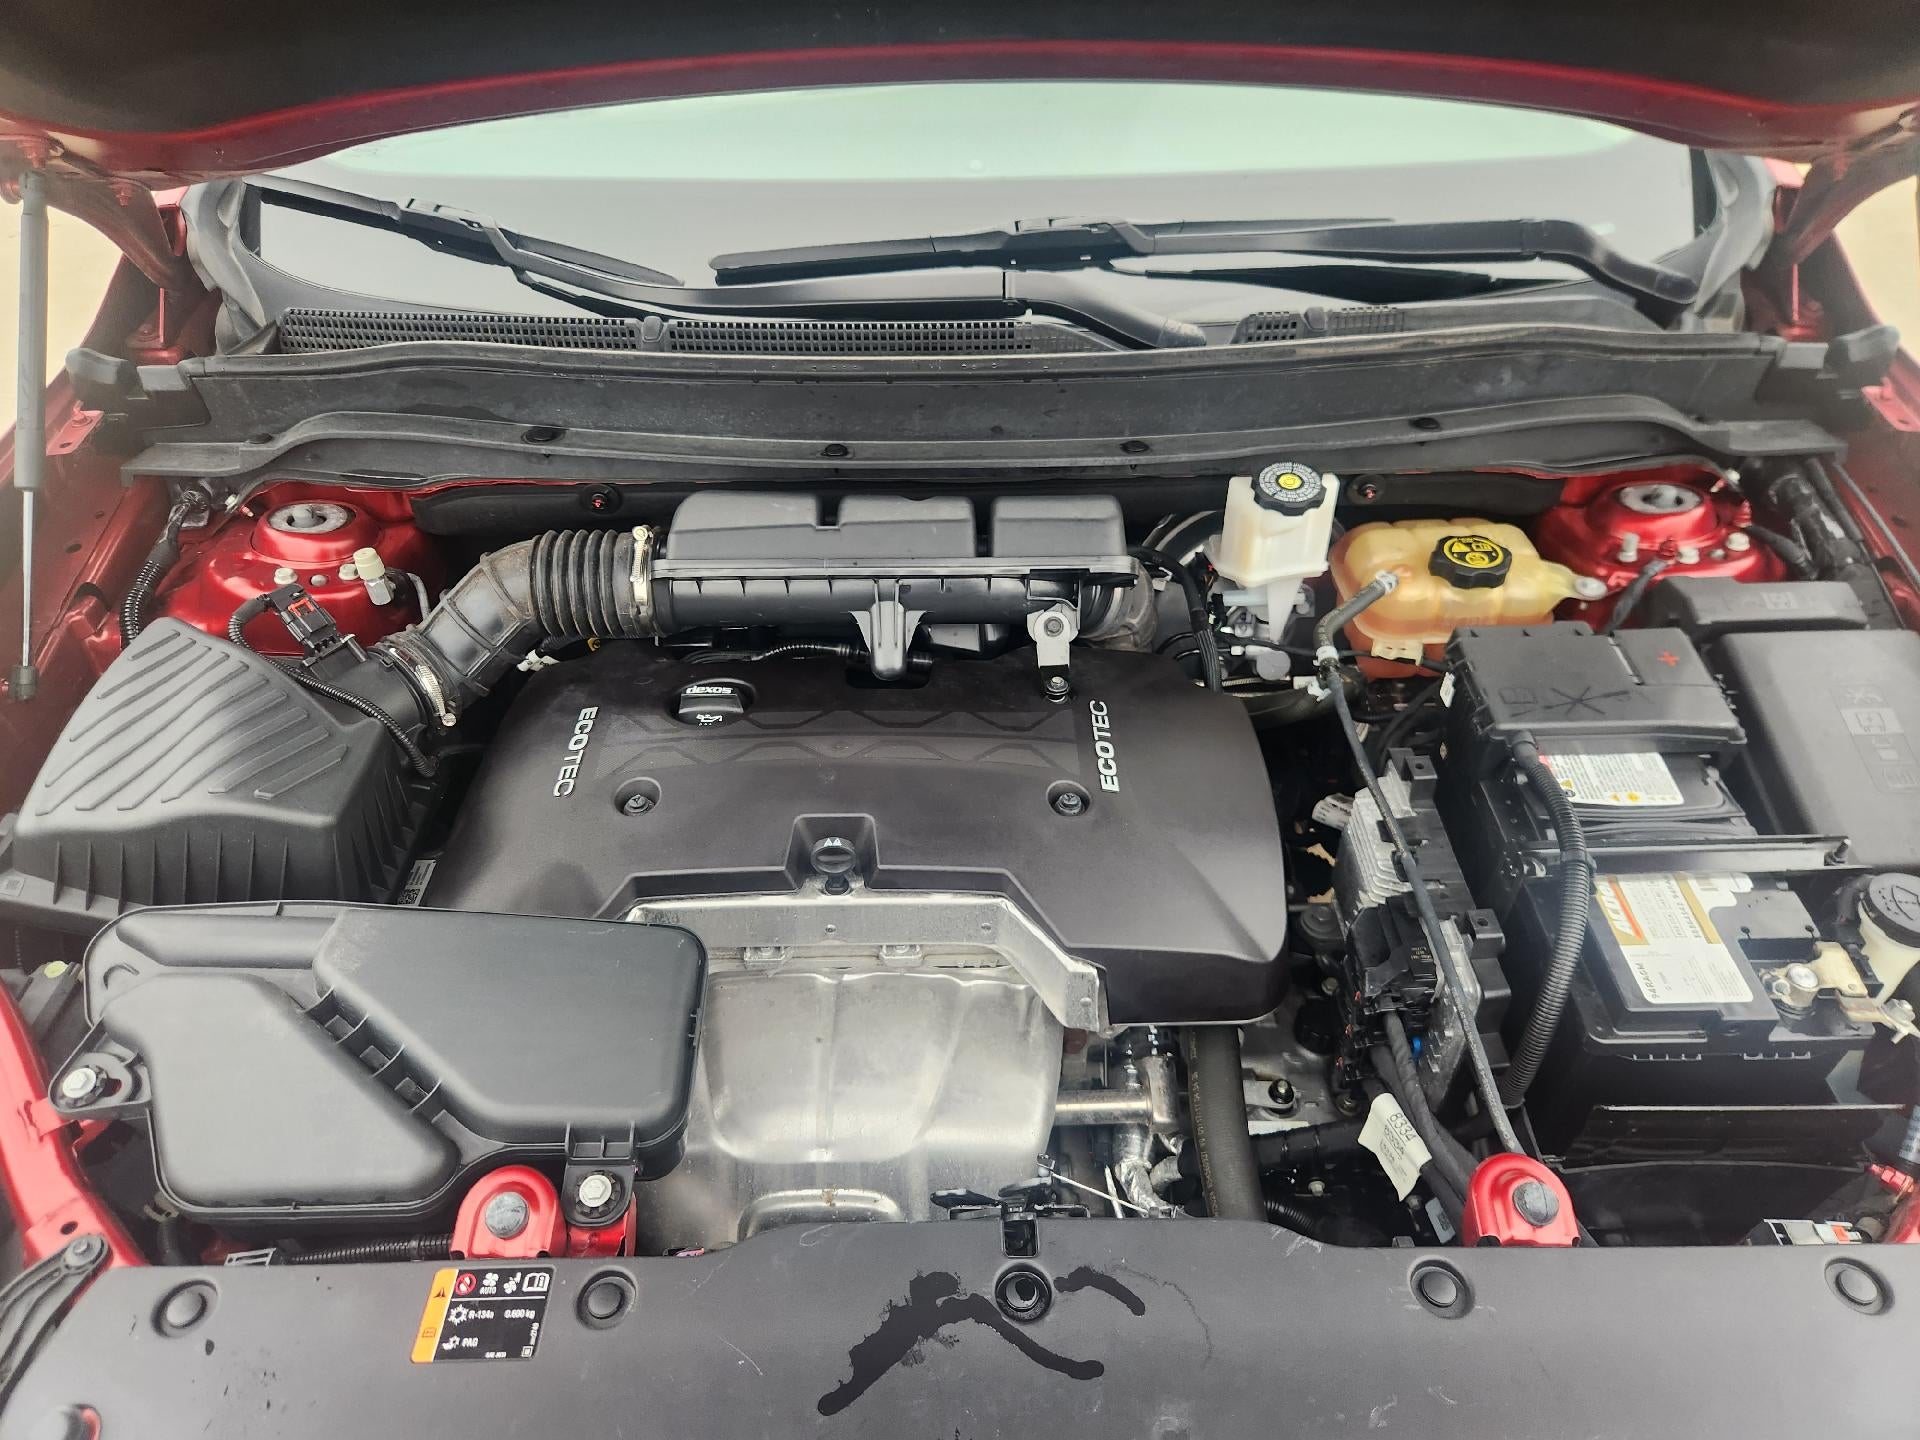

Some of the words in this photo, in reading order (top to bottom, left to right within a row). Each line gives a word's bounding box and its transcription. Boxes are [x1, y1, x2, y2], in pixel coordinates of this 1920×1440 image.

[685, 685, 733, 694] dexos
[553, 706, 599, 798] ECOTEC
[1089, 700, 1120, 793] ECOTEC
[479, 1286, 497, 1295] AUTO
